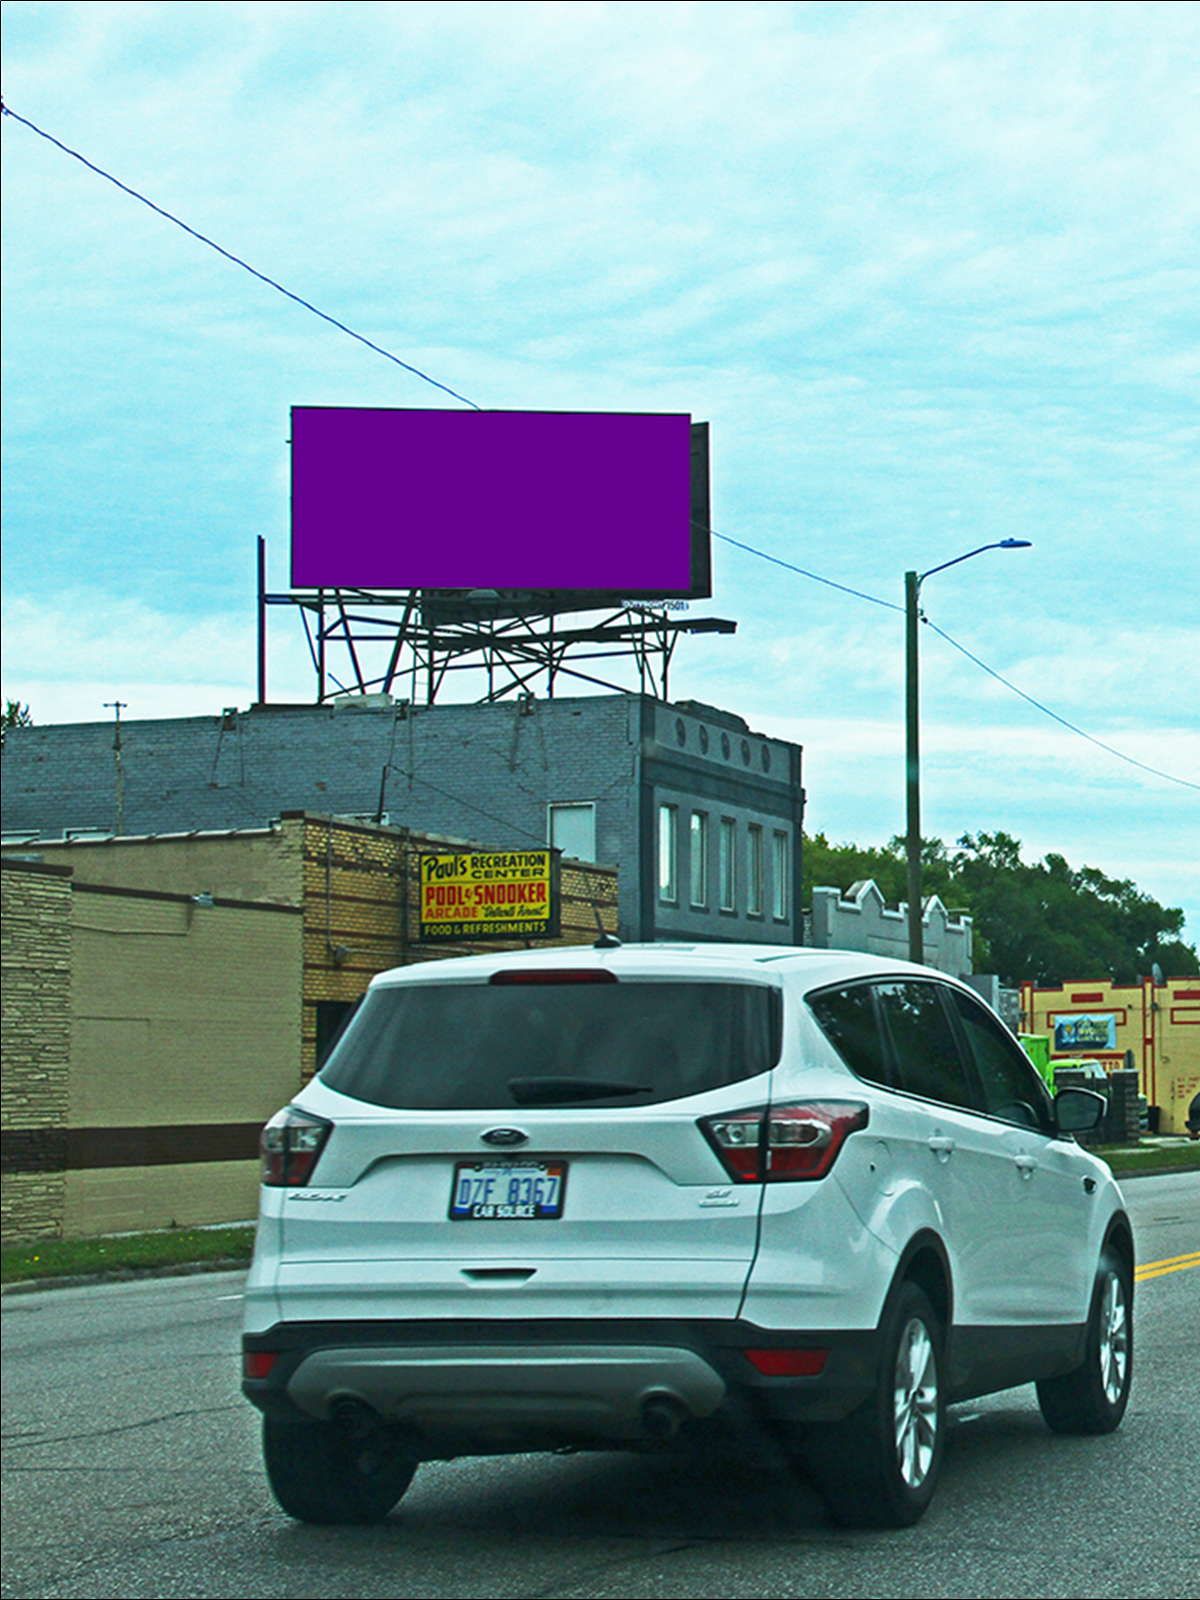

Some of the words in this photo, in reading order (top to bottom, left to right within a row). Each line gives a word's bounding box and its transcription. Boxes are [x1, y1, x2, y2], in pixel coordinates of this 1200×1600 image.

[423, 855, 468, 881] Paul's
[470, 853, 547, 869] RECREATION
[470, 867, 546, 879] CENTER
[425, 884, 466, 906] POOL
[474, 882, 547, 905] SNOOKER
[424, 906, 479, 919] ARCADE
[424, 924, 452, 935] FOOD
[462, 921, 547, 934] REFRESHMENTS
[507, 1178, 558, 1205] 8367
